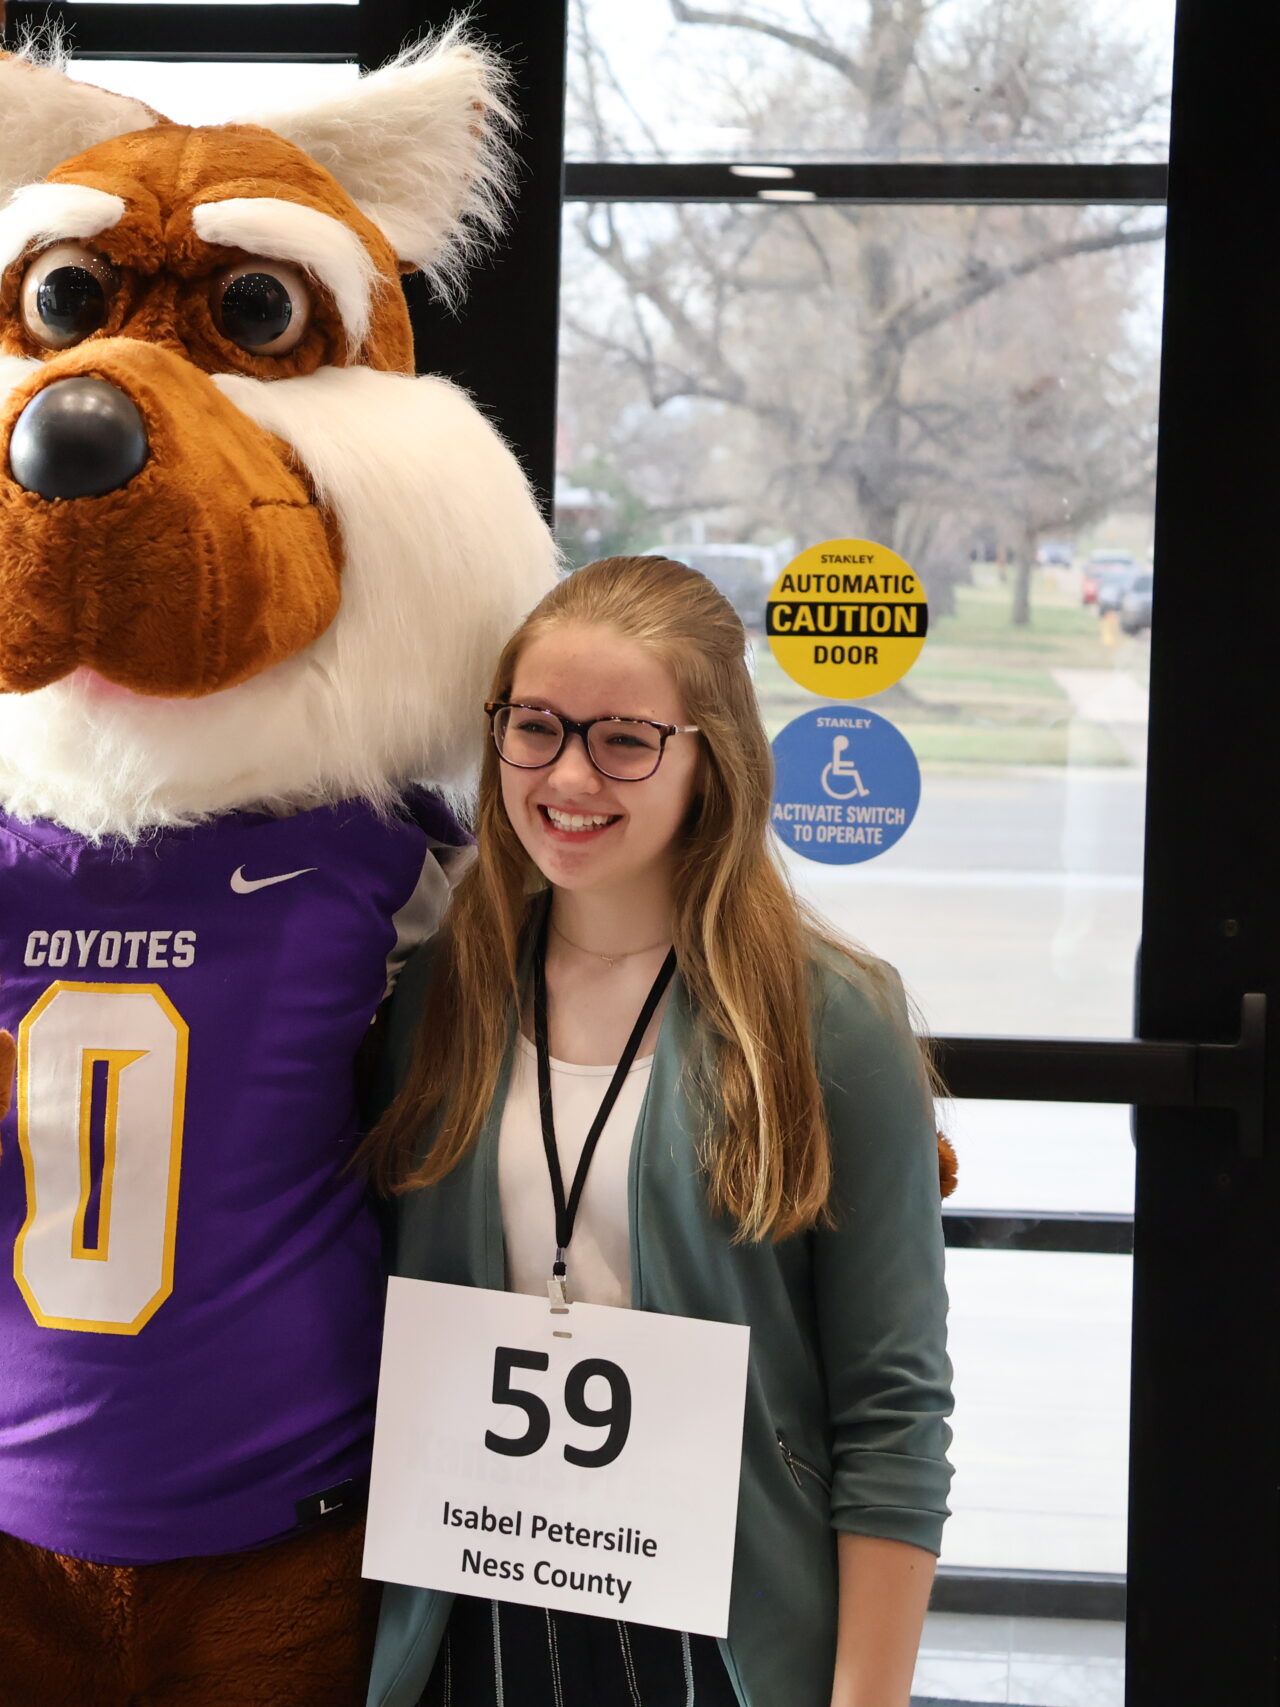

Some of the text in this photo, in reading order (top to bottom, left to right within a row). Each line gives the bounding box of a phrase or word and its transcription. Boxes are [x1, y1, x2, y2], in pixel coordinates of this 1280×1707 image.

[821, 554, 874, 564] STANLEY
[780, 574, 915, 594] AUTOMATIC
[772, 604, 917, 633] CAUTION
[814, 645, 879, 664] DOOR
[816, 717, 872, 729] STANLEY
[773, 803, 906, 825] ACTIVATE SWITCH
[793, 824, 883, 845] TO OPERATE
[23, 929, 197, 969] COYOTES
[484, 1346, 632, 1469] 59
[442, 1501, 658, 1558] Isabel Petersilie
[461, 1548, 632, 1604] Ness County
